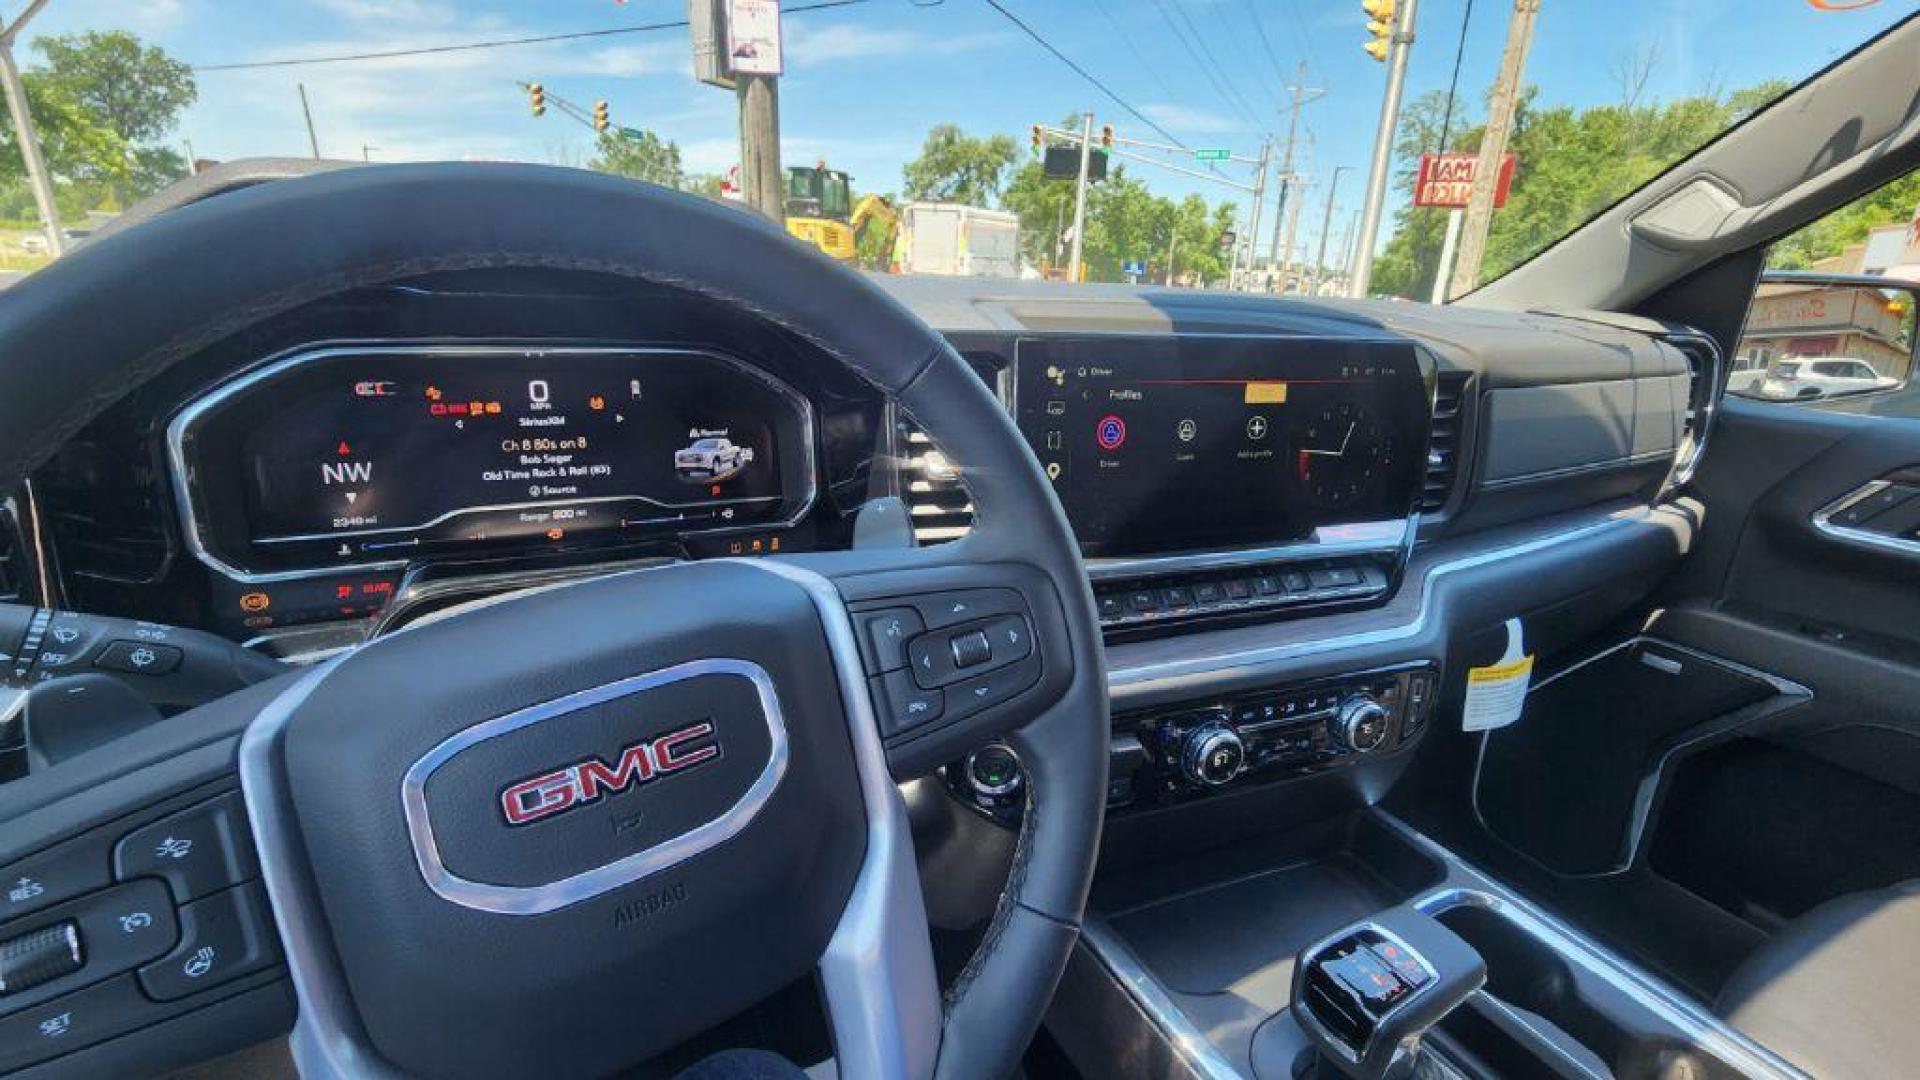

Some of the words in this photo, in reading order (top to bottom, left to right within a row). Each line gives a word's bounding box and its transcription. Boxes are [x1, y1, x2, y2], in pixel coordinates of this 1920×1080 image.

[1109, 389, 1143, 401] Profiles
[518, 415, 566, 427] SiriusXM
[501, 440, 521, 452] Ch
[560, 438, 577, 449] on
[520, 455, 542, 466] Bob
[322, 461, 373, 485] NW
[482, 470, 504, 481] Old
[504, 469, 531, 480] Time
[532, 466, 558, 478] Rock
[569, 465, 589, 476] Roll
[541, 485, 578, 496] Source
[502, 723, 718, 824] GMC
[8, 882, 45, 904] RES
[613, 882, 688, 928] AIRBAG
[38, 1011, 72, 1036] SET
